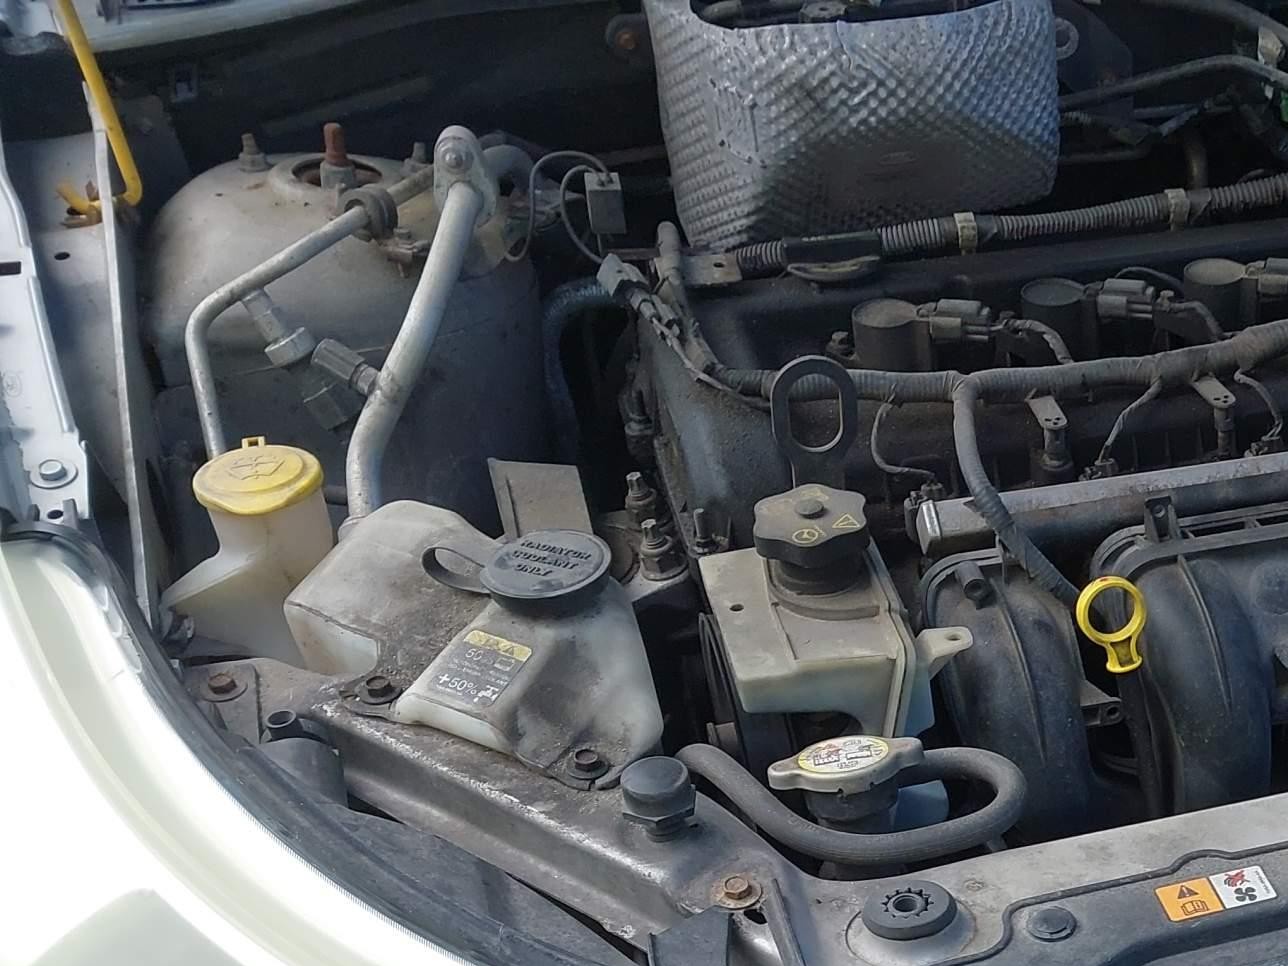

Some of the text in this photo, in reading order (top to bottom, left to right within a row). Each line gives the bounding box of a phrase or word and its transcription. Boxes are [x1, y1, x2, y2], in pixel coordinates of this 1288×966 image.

[520, 539, 592, 560] RADIATOR
[511, 550, 579, 570] COOLANT
[514, 563, 553, 577] ONLY
